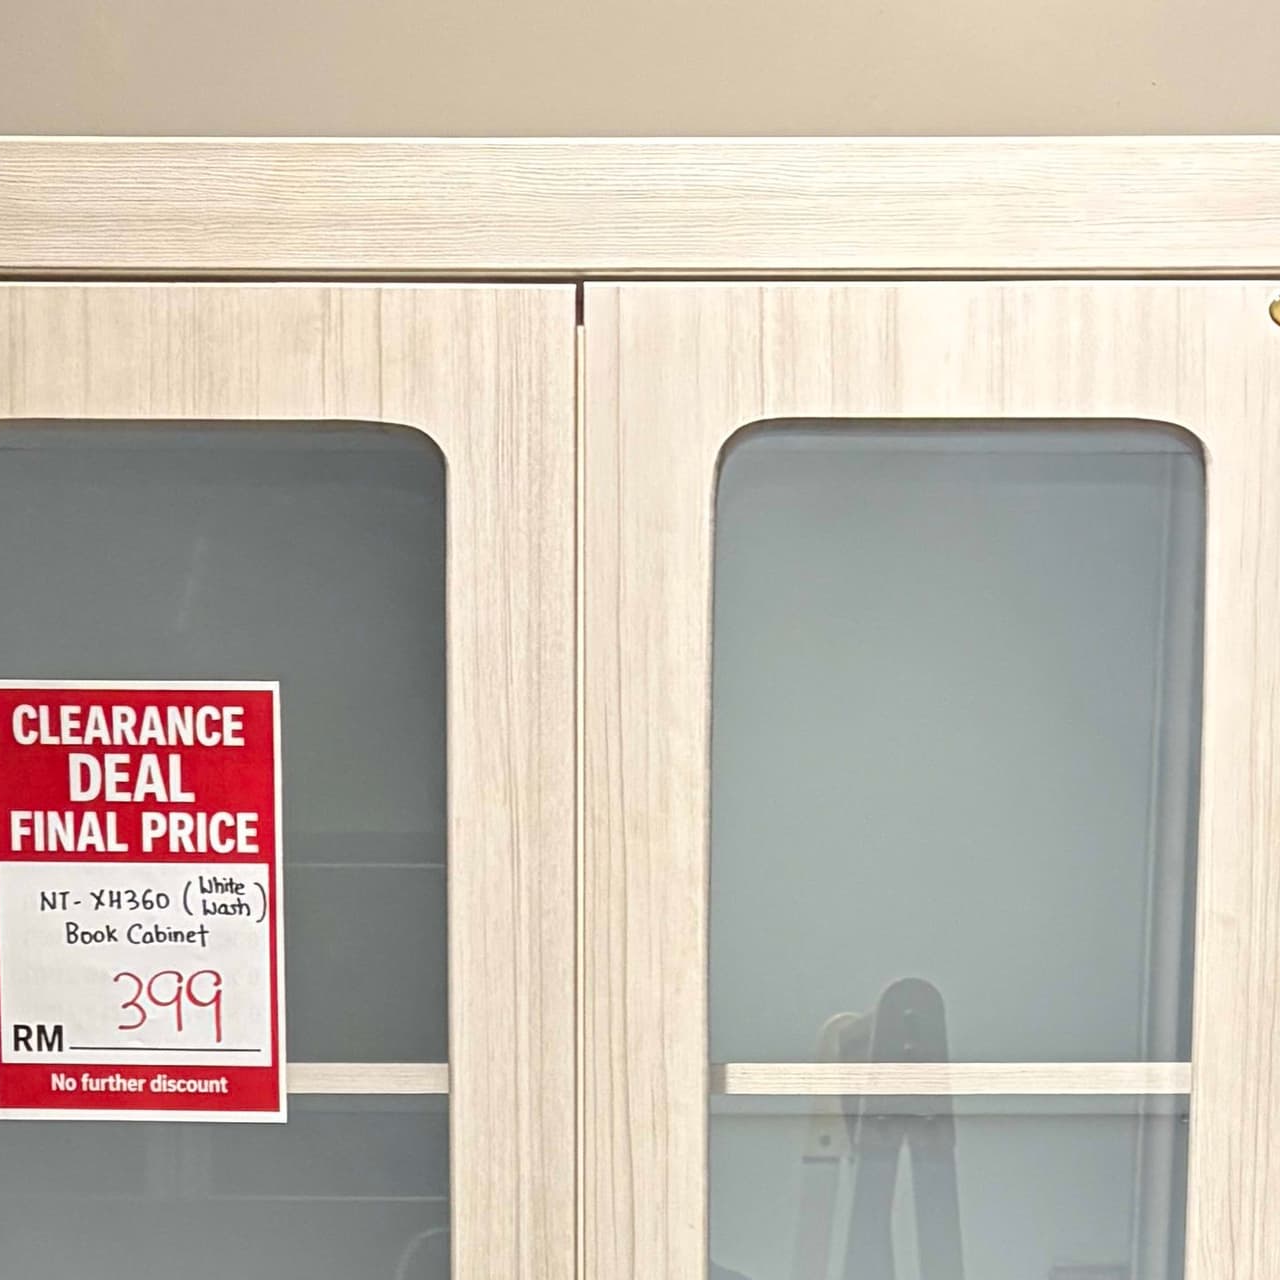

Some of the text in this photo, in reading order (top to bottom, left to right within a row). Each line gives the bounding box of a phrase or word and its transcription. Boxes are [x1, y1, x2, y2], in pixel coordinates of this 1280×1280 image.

[12, 704, 245, 747] CLEARANCE
[68, 753, 196, 803] DEAL
[10, 810, 260, 854] FINAL PRICE
[65, 921, 210, 947] Book Cabinet
[13, 969, 223, 1053] RM 399
[50, 1073, 229, 1094] No further discount
